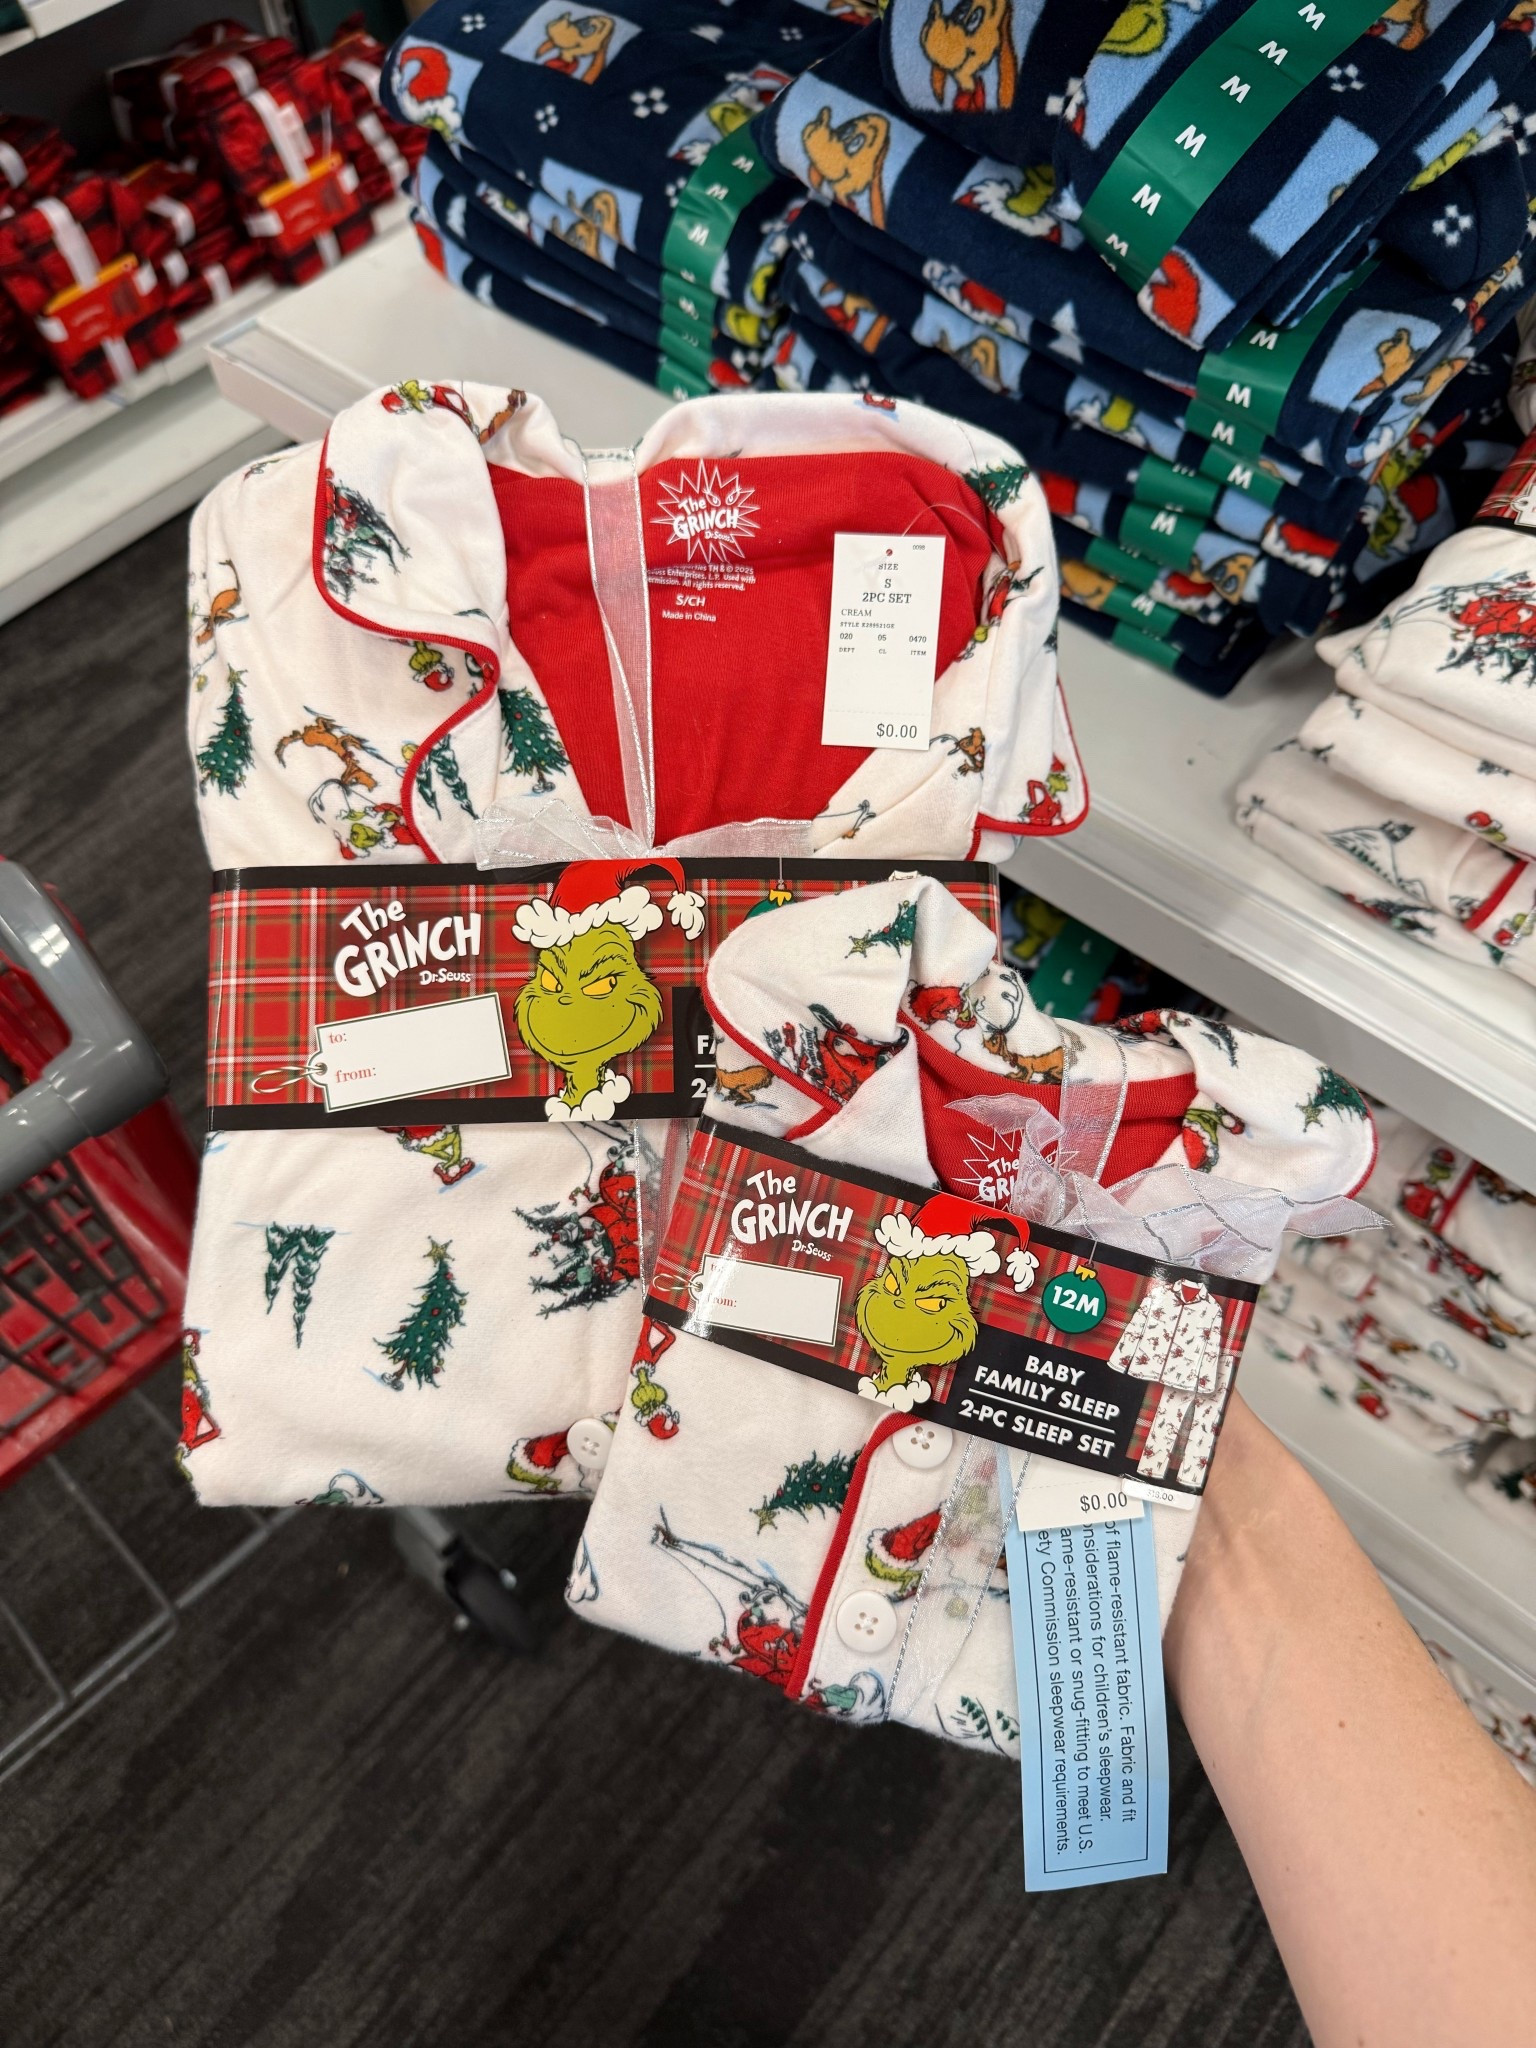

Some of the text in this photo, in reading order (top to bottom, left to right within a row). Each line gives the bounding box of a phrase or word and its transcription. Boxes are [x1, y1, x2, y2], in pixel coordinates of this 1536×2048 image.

[1297, 2, 1326, 31] M
[1258, 40, 1288, 66] M
[1220, 75, 1251, 103] M
[1174, 124, 1207, 158] M
[732, 155, 754, 174] M
[706, 182, 729, 201] M
[1131, 183, 1162, 216] M
[687, 223, 710, 247] M
[1106, 233, 1129, 257] M
[1249, 330, 1279, 351] M
[1225, 382, 1252, 408] M
[1211, 420, 1236, 446] M
[1227, 463, 1253, 490] M
[678, 495, 706, 515] The
[673, 508, 739, 539] GRINCH
[1151, 510, 1178, 536] M
[723, 574, 739, 582] Used
[740, 575, 756, 585] with
[734, 566, 754, 575] 2025
[878, 563, 899, 571] SIZE
[682, 579, 692, 588] All
[693, 580, 713, 592] rights
[884, 578, 892, 589] S
[675, 593, 706, 607] S/CH
[862, 592, 912, 604] 2PC SET
[1130, 593, 1156, 617] M
[662, 610, 717, 622] Made in China
[841, 608, 872, 617] CREAM
[839, 632, 853, 640] 020
[909, 635, 927, 643] 0470
[876, 722, 918, 739] $0.00
[339, 900, 407, 941] The
[334, 912, 482, 998] GRINCH
[328, 1031, 347, 1045] to:
[335, 1066, 377, 1084] from:
[987, 1156, 1020, 1177] The
[746, 1169, 797, 1200] The
[731, 1197, 854, 1245] GRINCH
[1051, 1284, 1100, 1317] 12M
[1025, 1354, 1086, 1386] BABY
[974, 1365, 1120, 1421] FAMILY SLEEP
[958, 1399, 1115, 1460] 2-PC SLEEP SET
[1079, 1491, 1128, 1513] $0.00
[1041, 1561, 1062, 1666] Commission
[1106, 1540, 1130, 1664] flame-resistant
[1070, 1648, 1083, 1666] or
[1092, 1635, 1106, 1658] for
[1116, 1669, 1134, 1720] fabric.
[1049, 1672, 1066, 1754] sleepwear
[1071, 1671, 1091, 1762] snug-fitting
[1120, 1725, 1136, 1775] Fabric
[1078, 1765, 1091, 1781] to
[1097, 1746, 1114, 1822] sleepwear.
[1078, 1785, 1092, 1820] meet
[1122, 1779, 1137, 1805] and
[1052, 1758, 1071, 1855] requirements.
[1122, 1807, 1137, 1823] fit
[1078, 1823, 1093, 1854] U.S.
